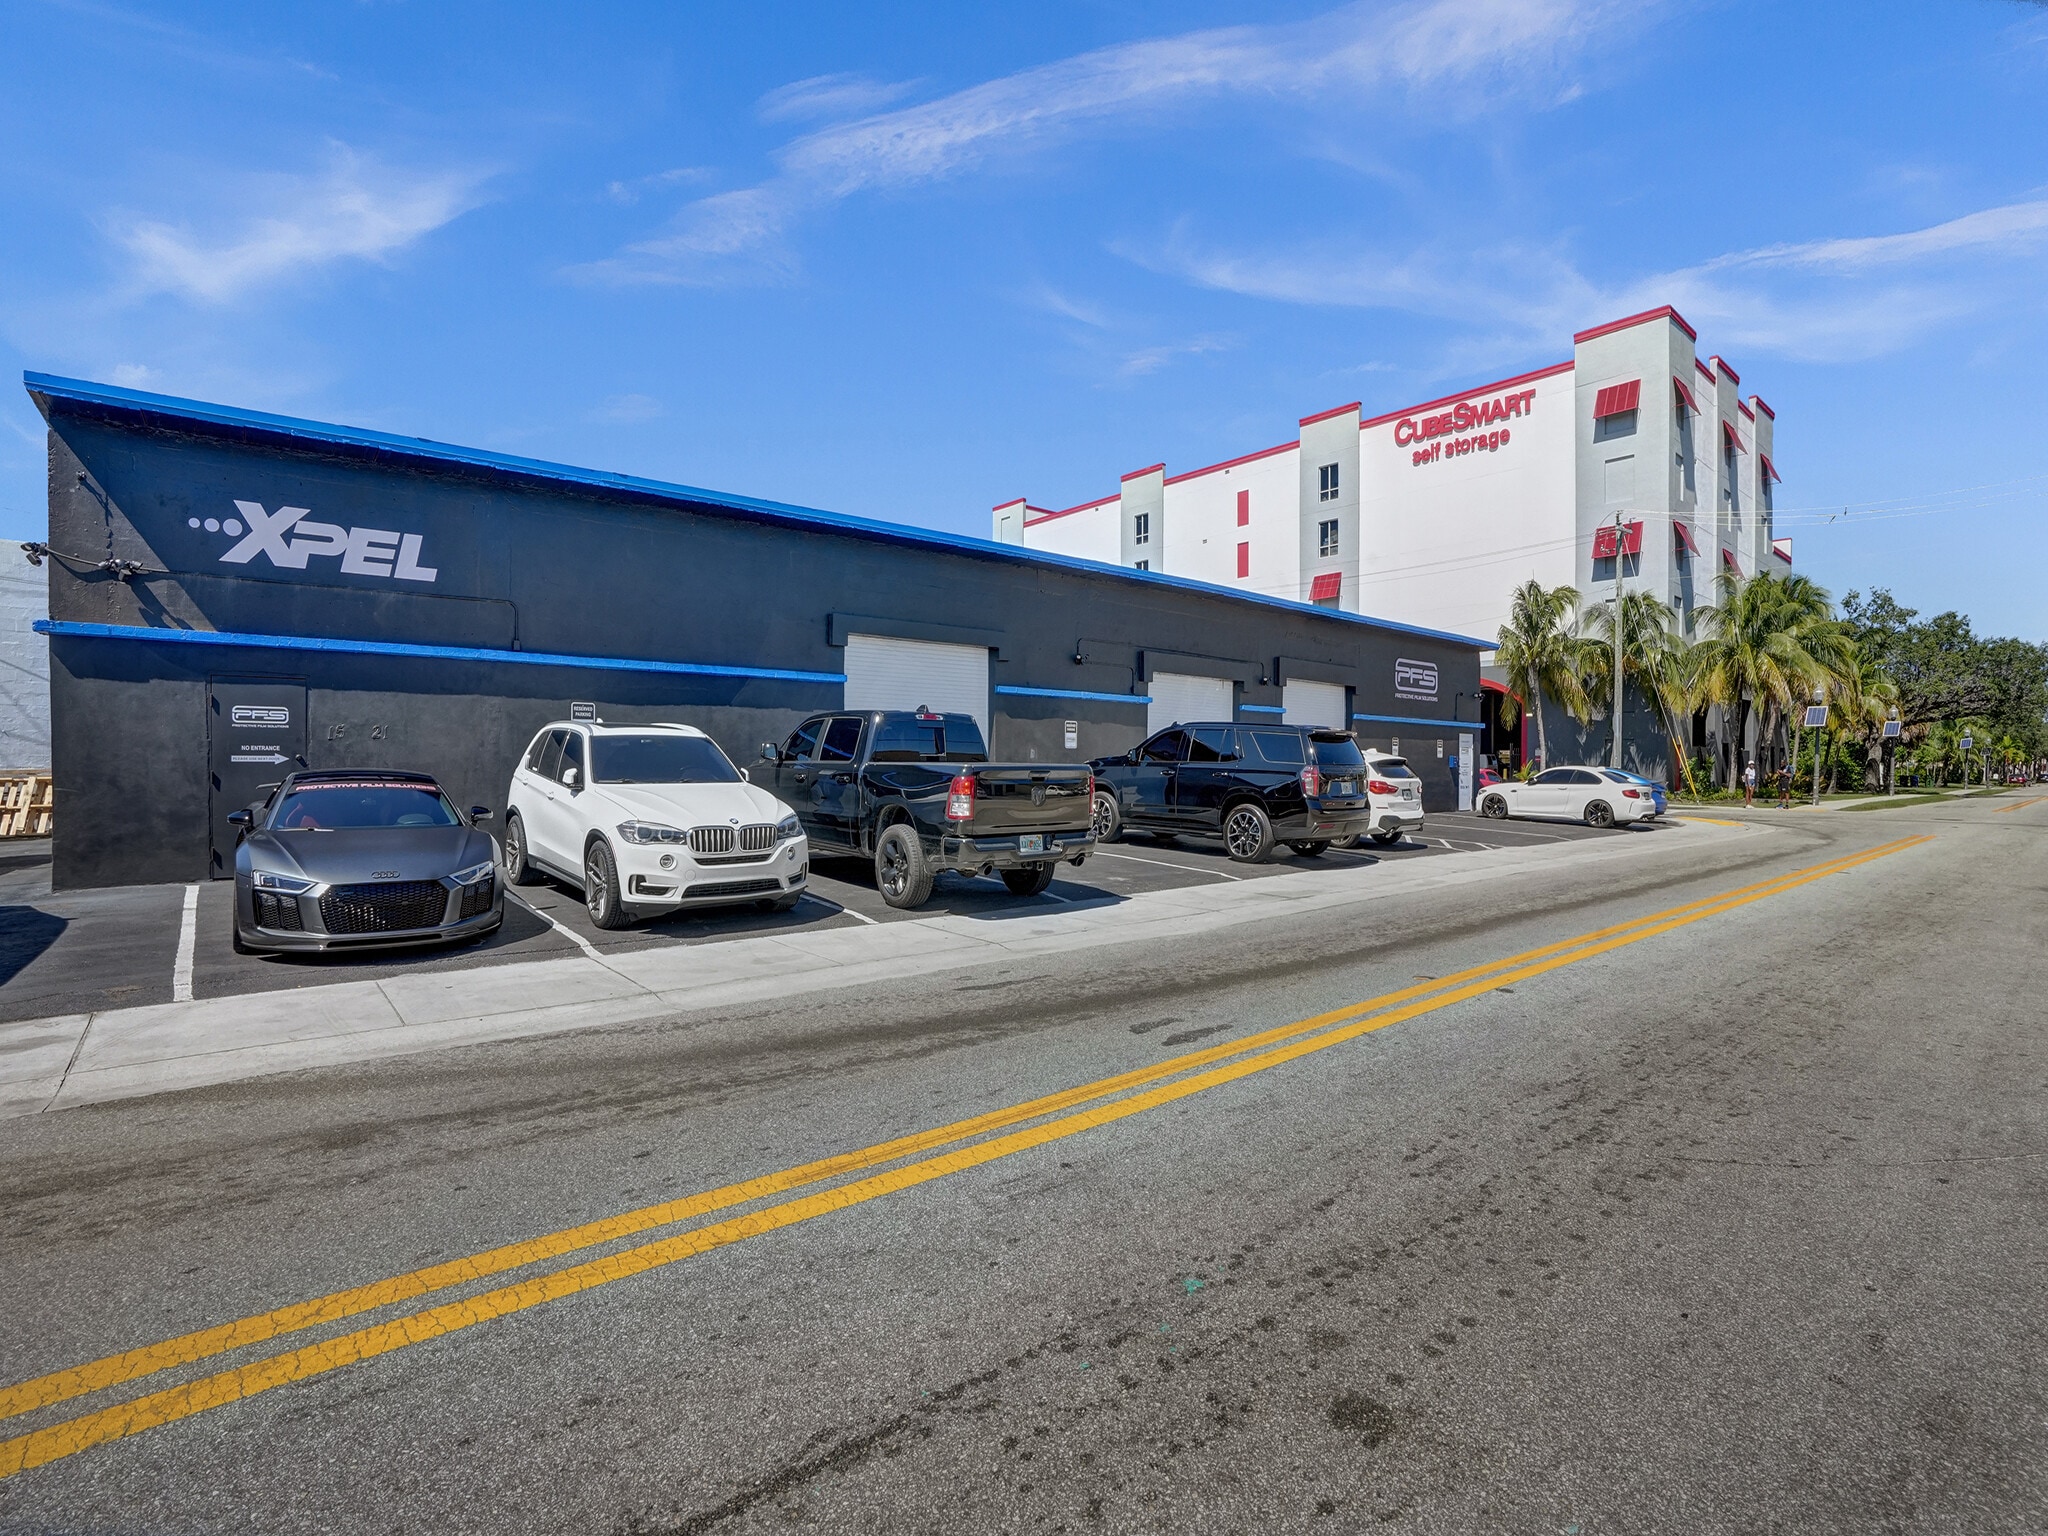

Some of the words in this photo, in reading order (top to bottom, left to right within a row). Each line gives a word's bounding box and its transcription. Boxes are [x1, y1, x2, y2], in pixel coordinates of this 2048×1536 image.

[1412, 441, 1442, 467] self
[1445, 428, 1511, 460] storage
[218, 499, 438, 582] XPEL
[232, 708, 289, 721] PFS
[295, 783, 359, 791] PROTECTIVE
[385, 783, 436, 791] SOLUTIONS
